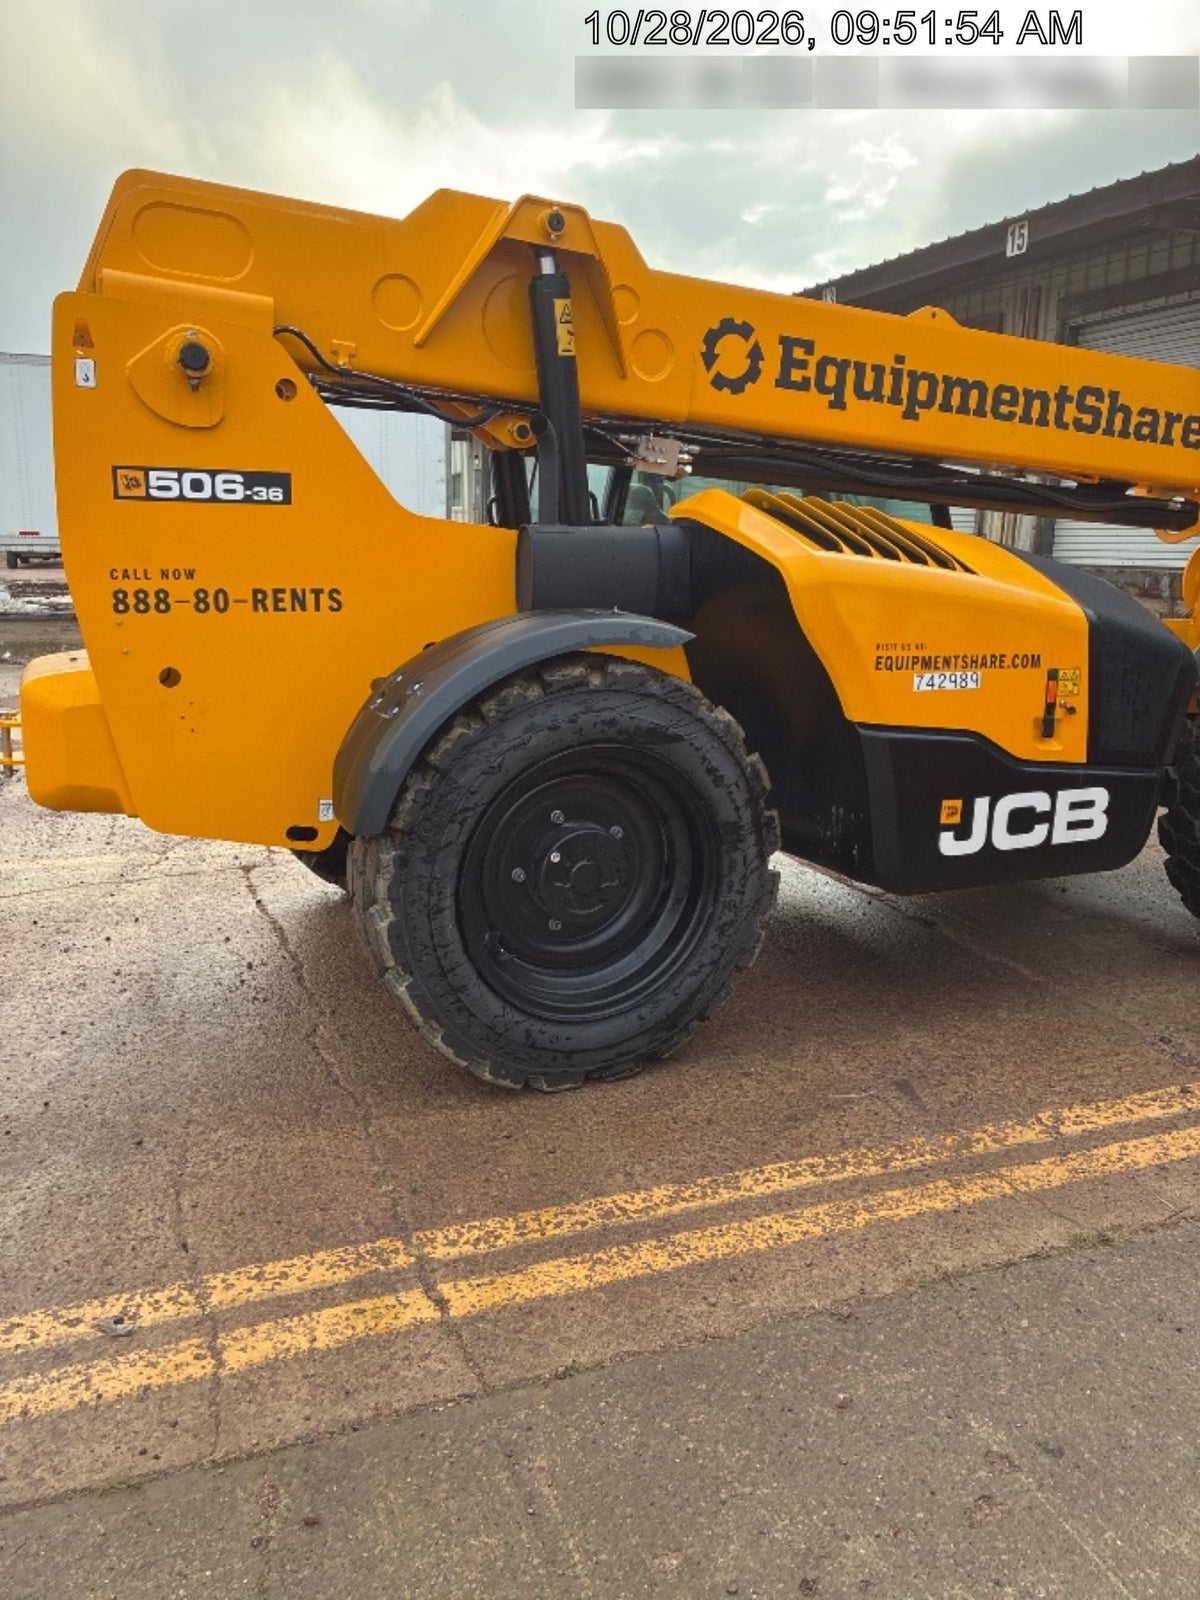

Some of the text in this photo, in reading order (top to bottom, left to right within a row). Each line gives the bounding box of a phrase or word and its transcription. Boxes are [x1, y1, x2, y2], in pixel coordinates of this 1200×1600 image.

[1009, 223, 1026, 254] 15
[775, 335, 1200, 449] EquipmentShare
[148, 470, 284, 501] 506-36
[109, 568, 196, 580] CALL NOW
[112, 587, 343, 614] 888-80-RENTS
[875, 653, 1041, 672] EQUIPMENTSHARE.COM
[915, 672, 979, 690] 742989
[938, 787, 1110, 856] JCB
